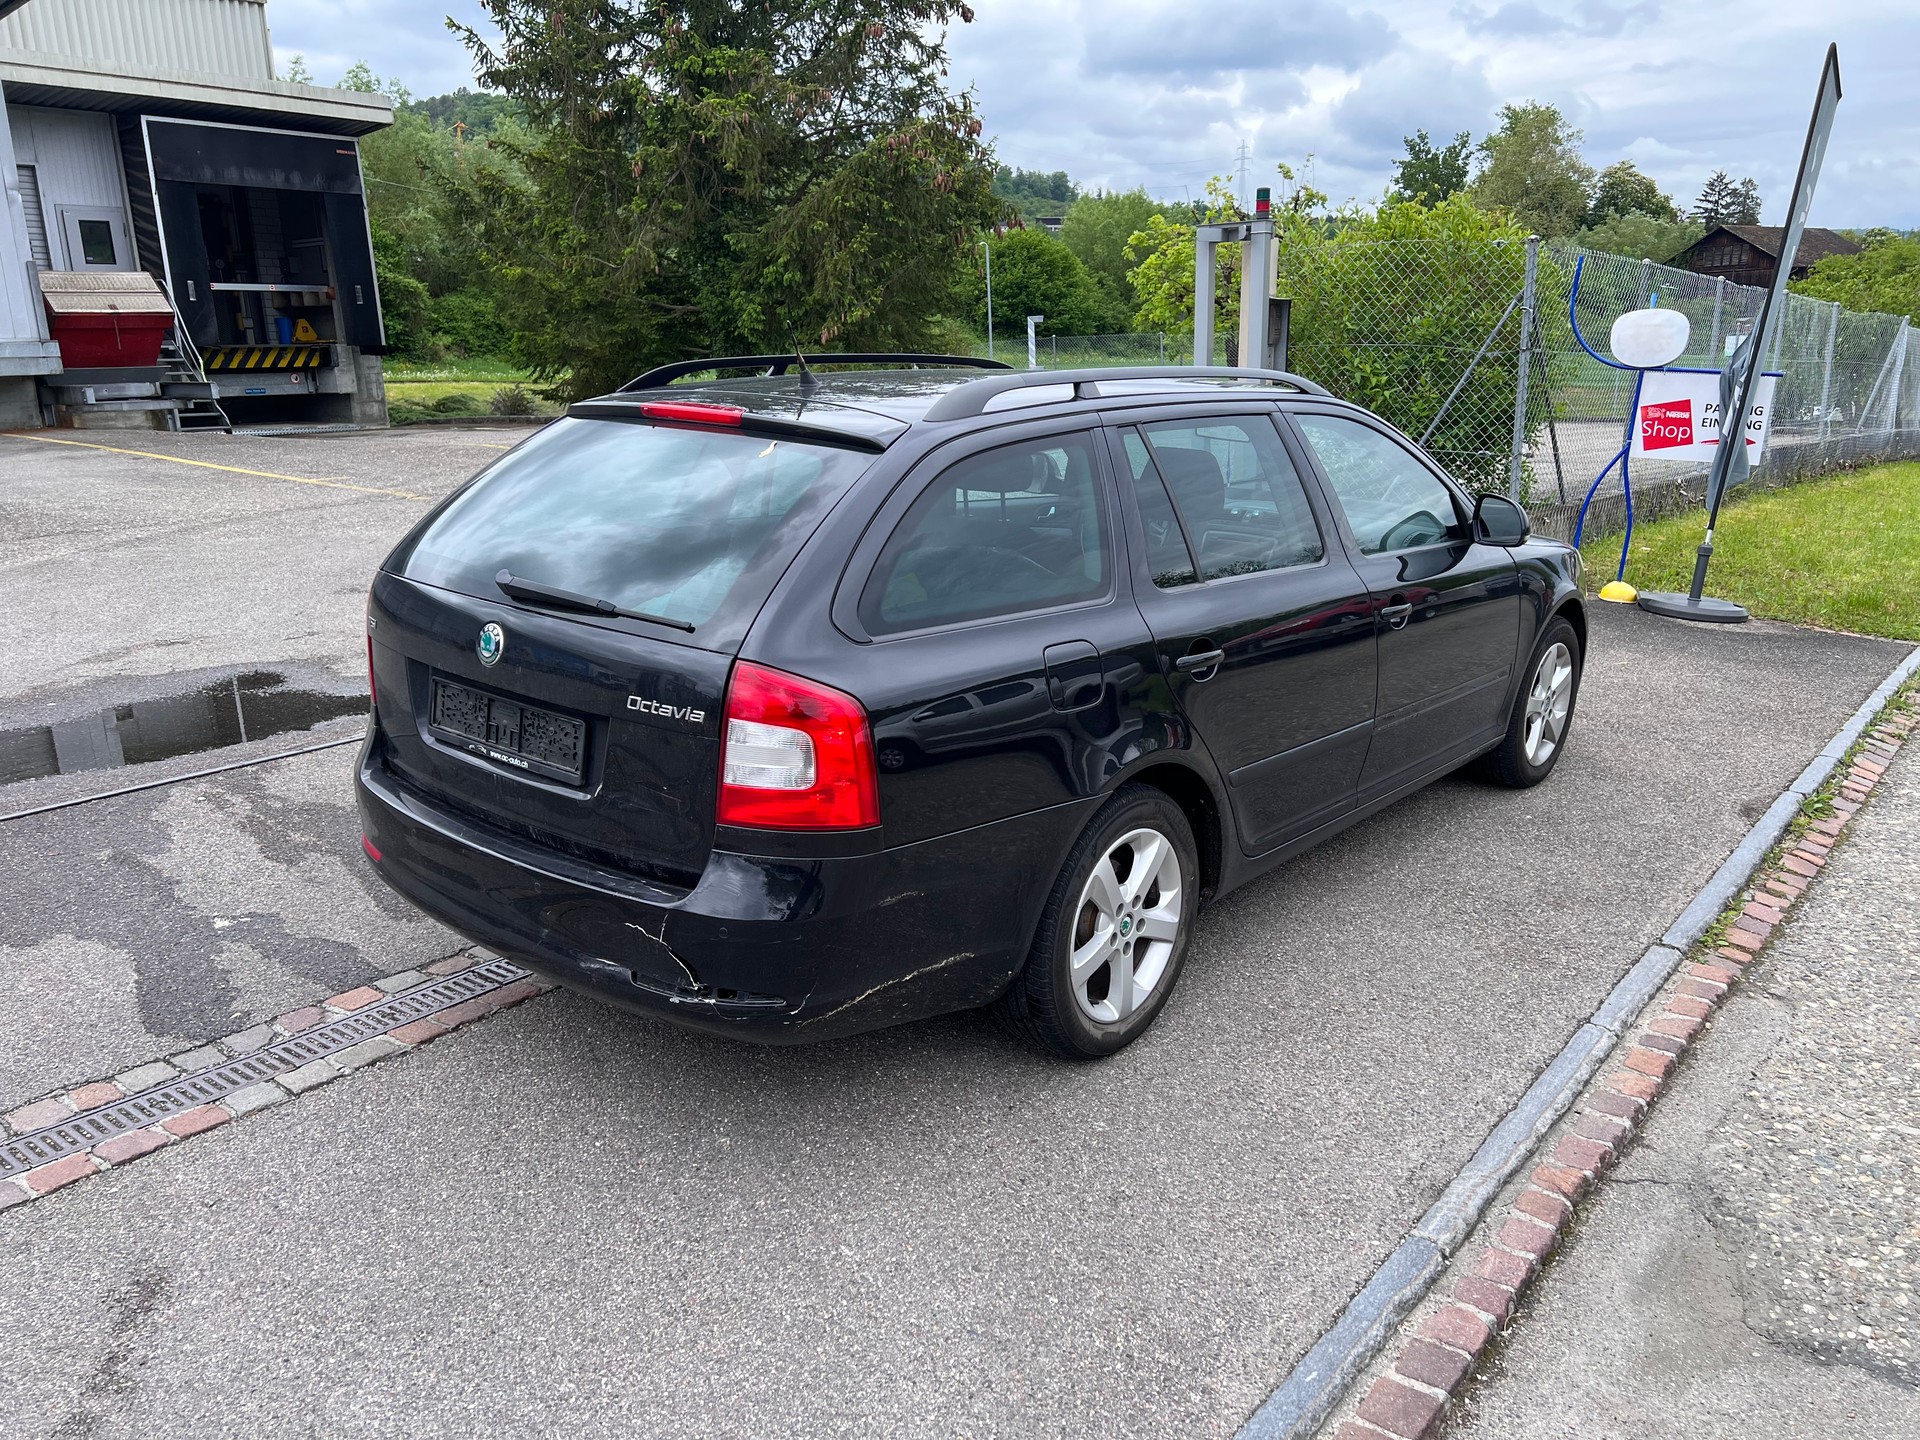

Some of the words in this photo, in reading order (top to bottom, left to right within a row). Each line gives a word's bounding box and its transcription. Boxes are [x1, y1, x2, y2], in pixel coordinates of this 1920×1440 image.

[1642, 420, 1691, 442] Shop
[1701, 417, 1763, 431] EINNG
[626, 695, 706, 723] Octavia
